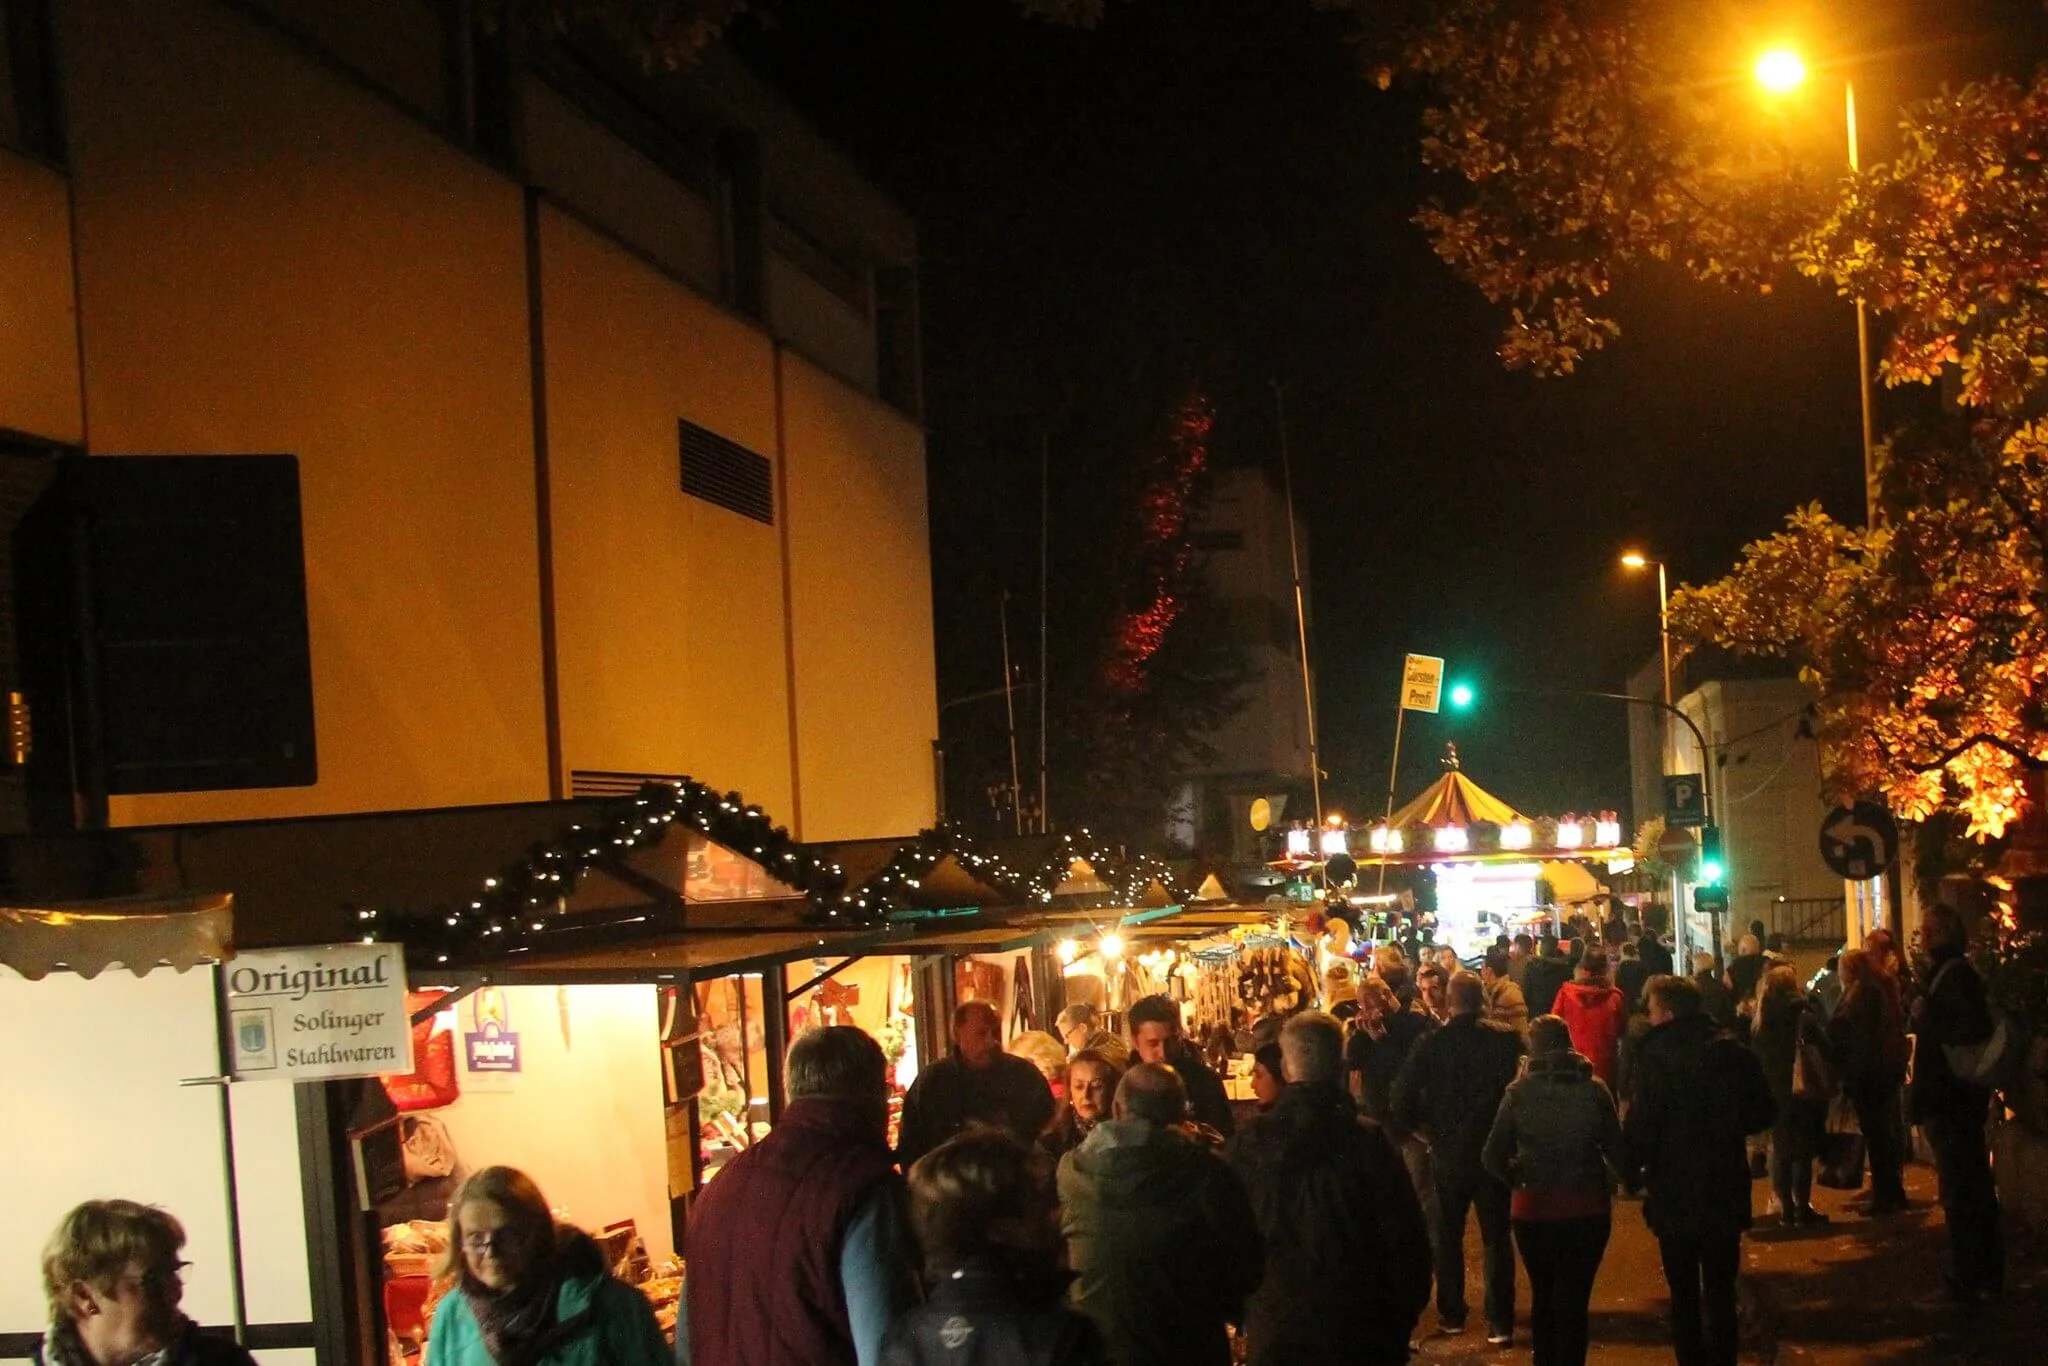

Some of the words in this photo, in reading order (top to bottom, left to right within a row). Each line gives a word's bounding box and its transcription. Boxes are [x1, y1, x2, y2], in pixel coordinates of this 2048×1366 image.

[1677, 785, 1692, 808] P
[231, 954, 389, 1001] Original
[293, 1009, 385, 1036] Solinger
[286, 1042, 397, 1067] Stahlwaren
